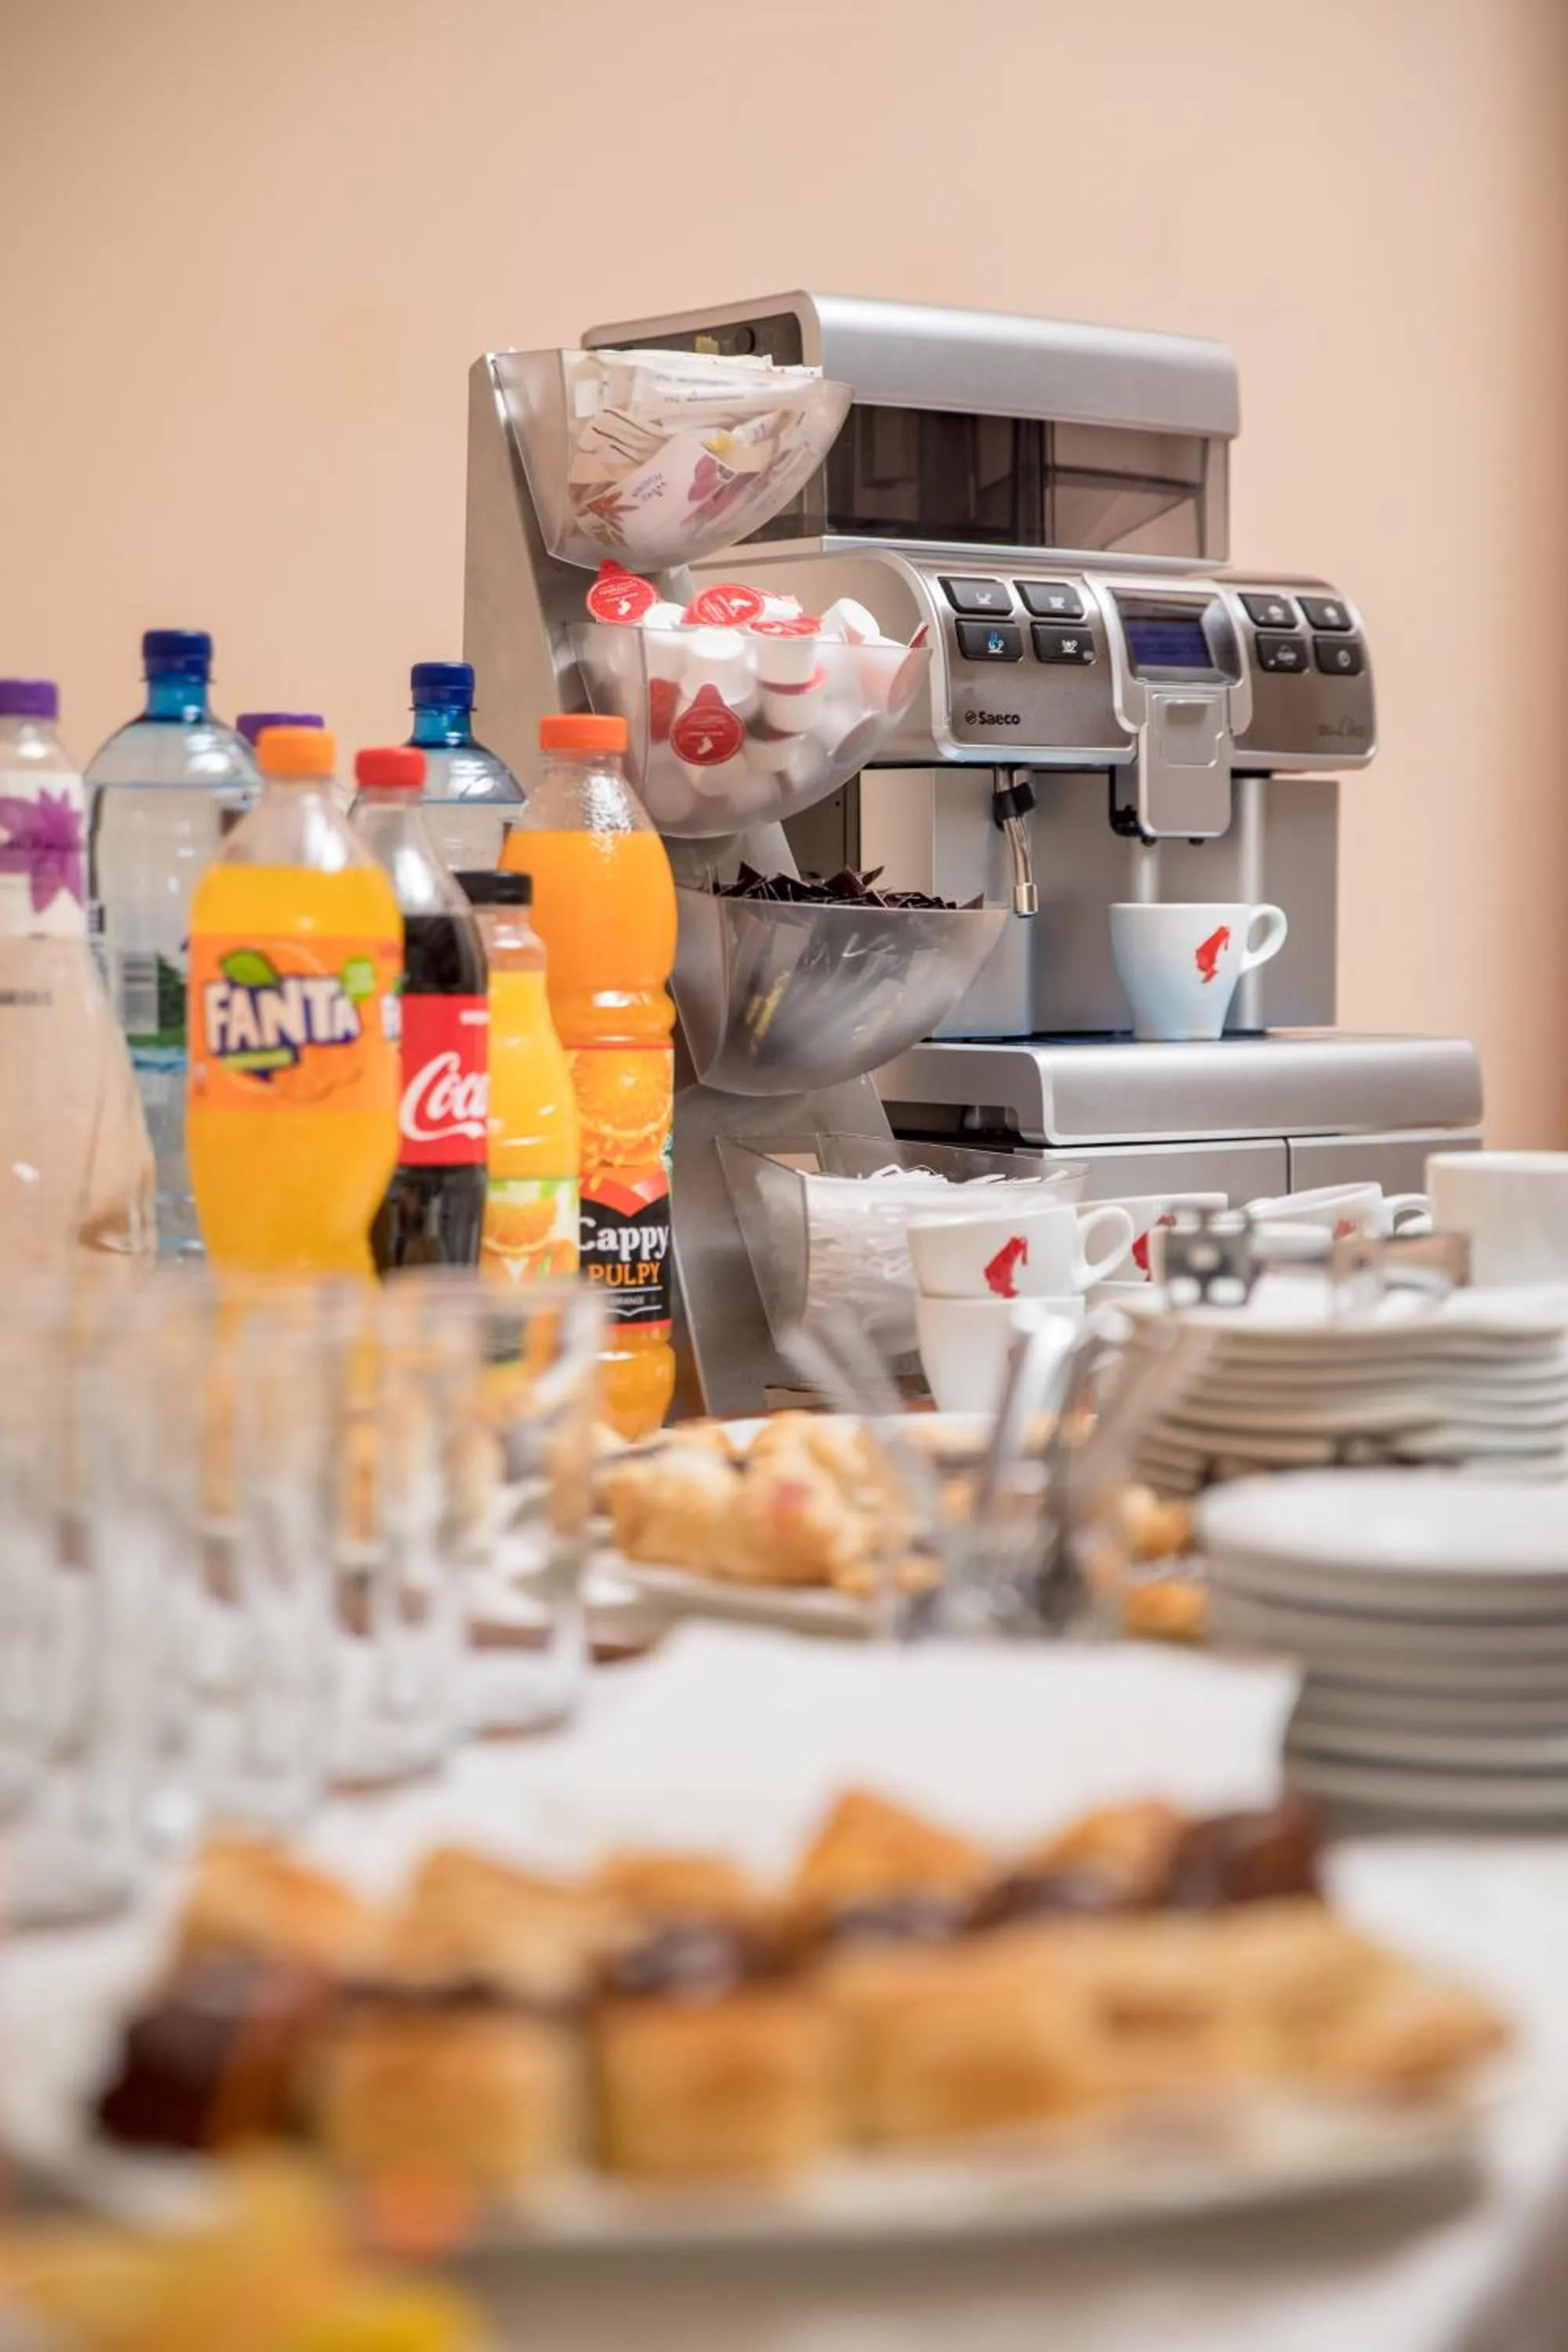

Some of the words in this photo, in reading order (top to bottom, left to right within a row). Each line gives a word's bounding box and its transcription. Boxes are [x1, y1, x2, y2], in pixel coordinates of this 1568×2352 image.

[978, 710, 1021, 725] Saeco
[204, 976, 361, 1054] FANTA
[588, 1261, 661, 1287] PULPY
